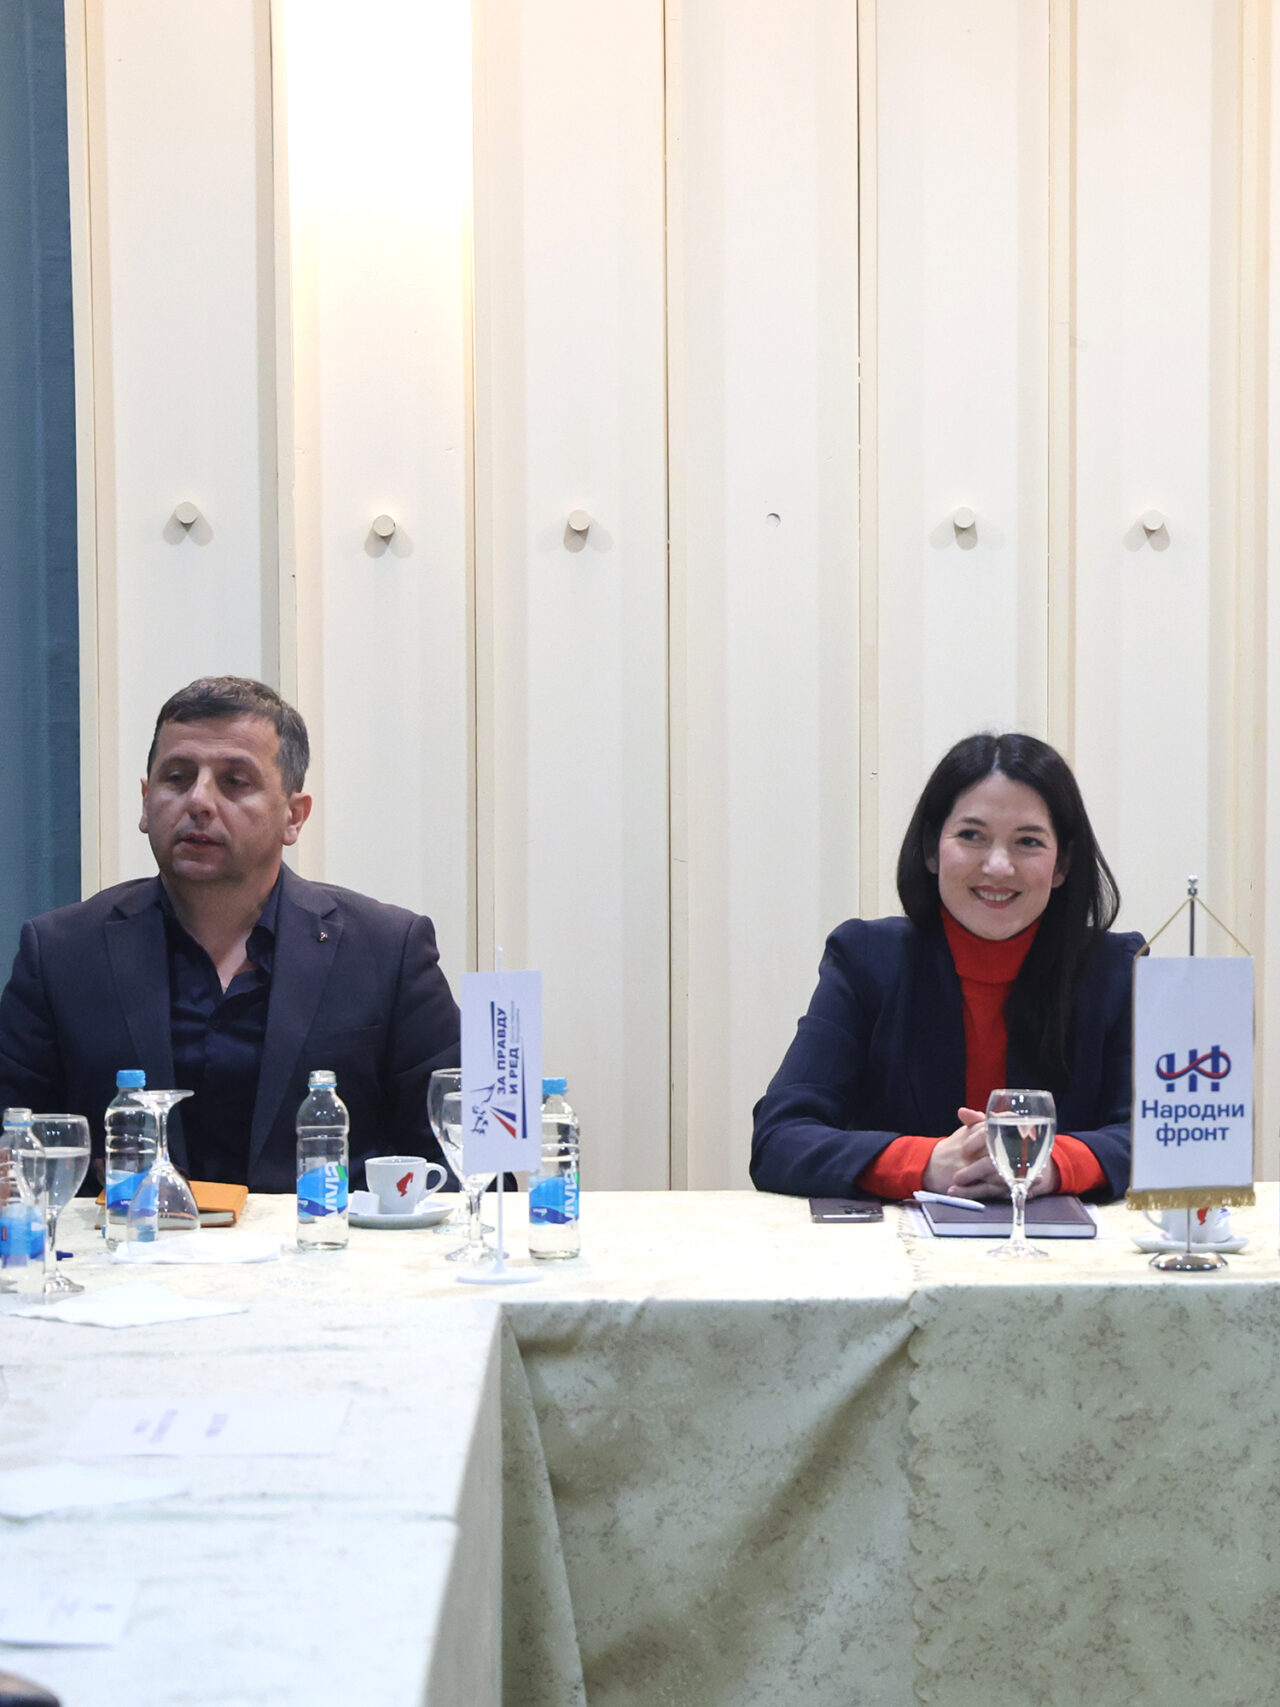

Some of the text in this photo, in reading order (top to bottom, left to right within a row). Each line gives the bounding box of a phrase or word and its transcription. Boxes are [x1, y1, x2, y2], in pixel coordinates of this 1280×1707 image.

[496, 1007, 508, 1095] ЗА ПРАВДУ
[509, 1047, 520, 1079] РЕД
[509, 1084, 519, 1095] И
[1141, 1099, 1245, 1123] Народни
[1156, 1122, 1230, 1147] фронт
